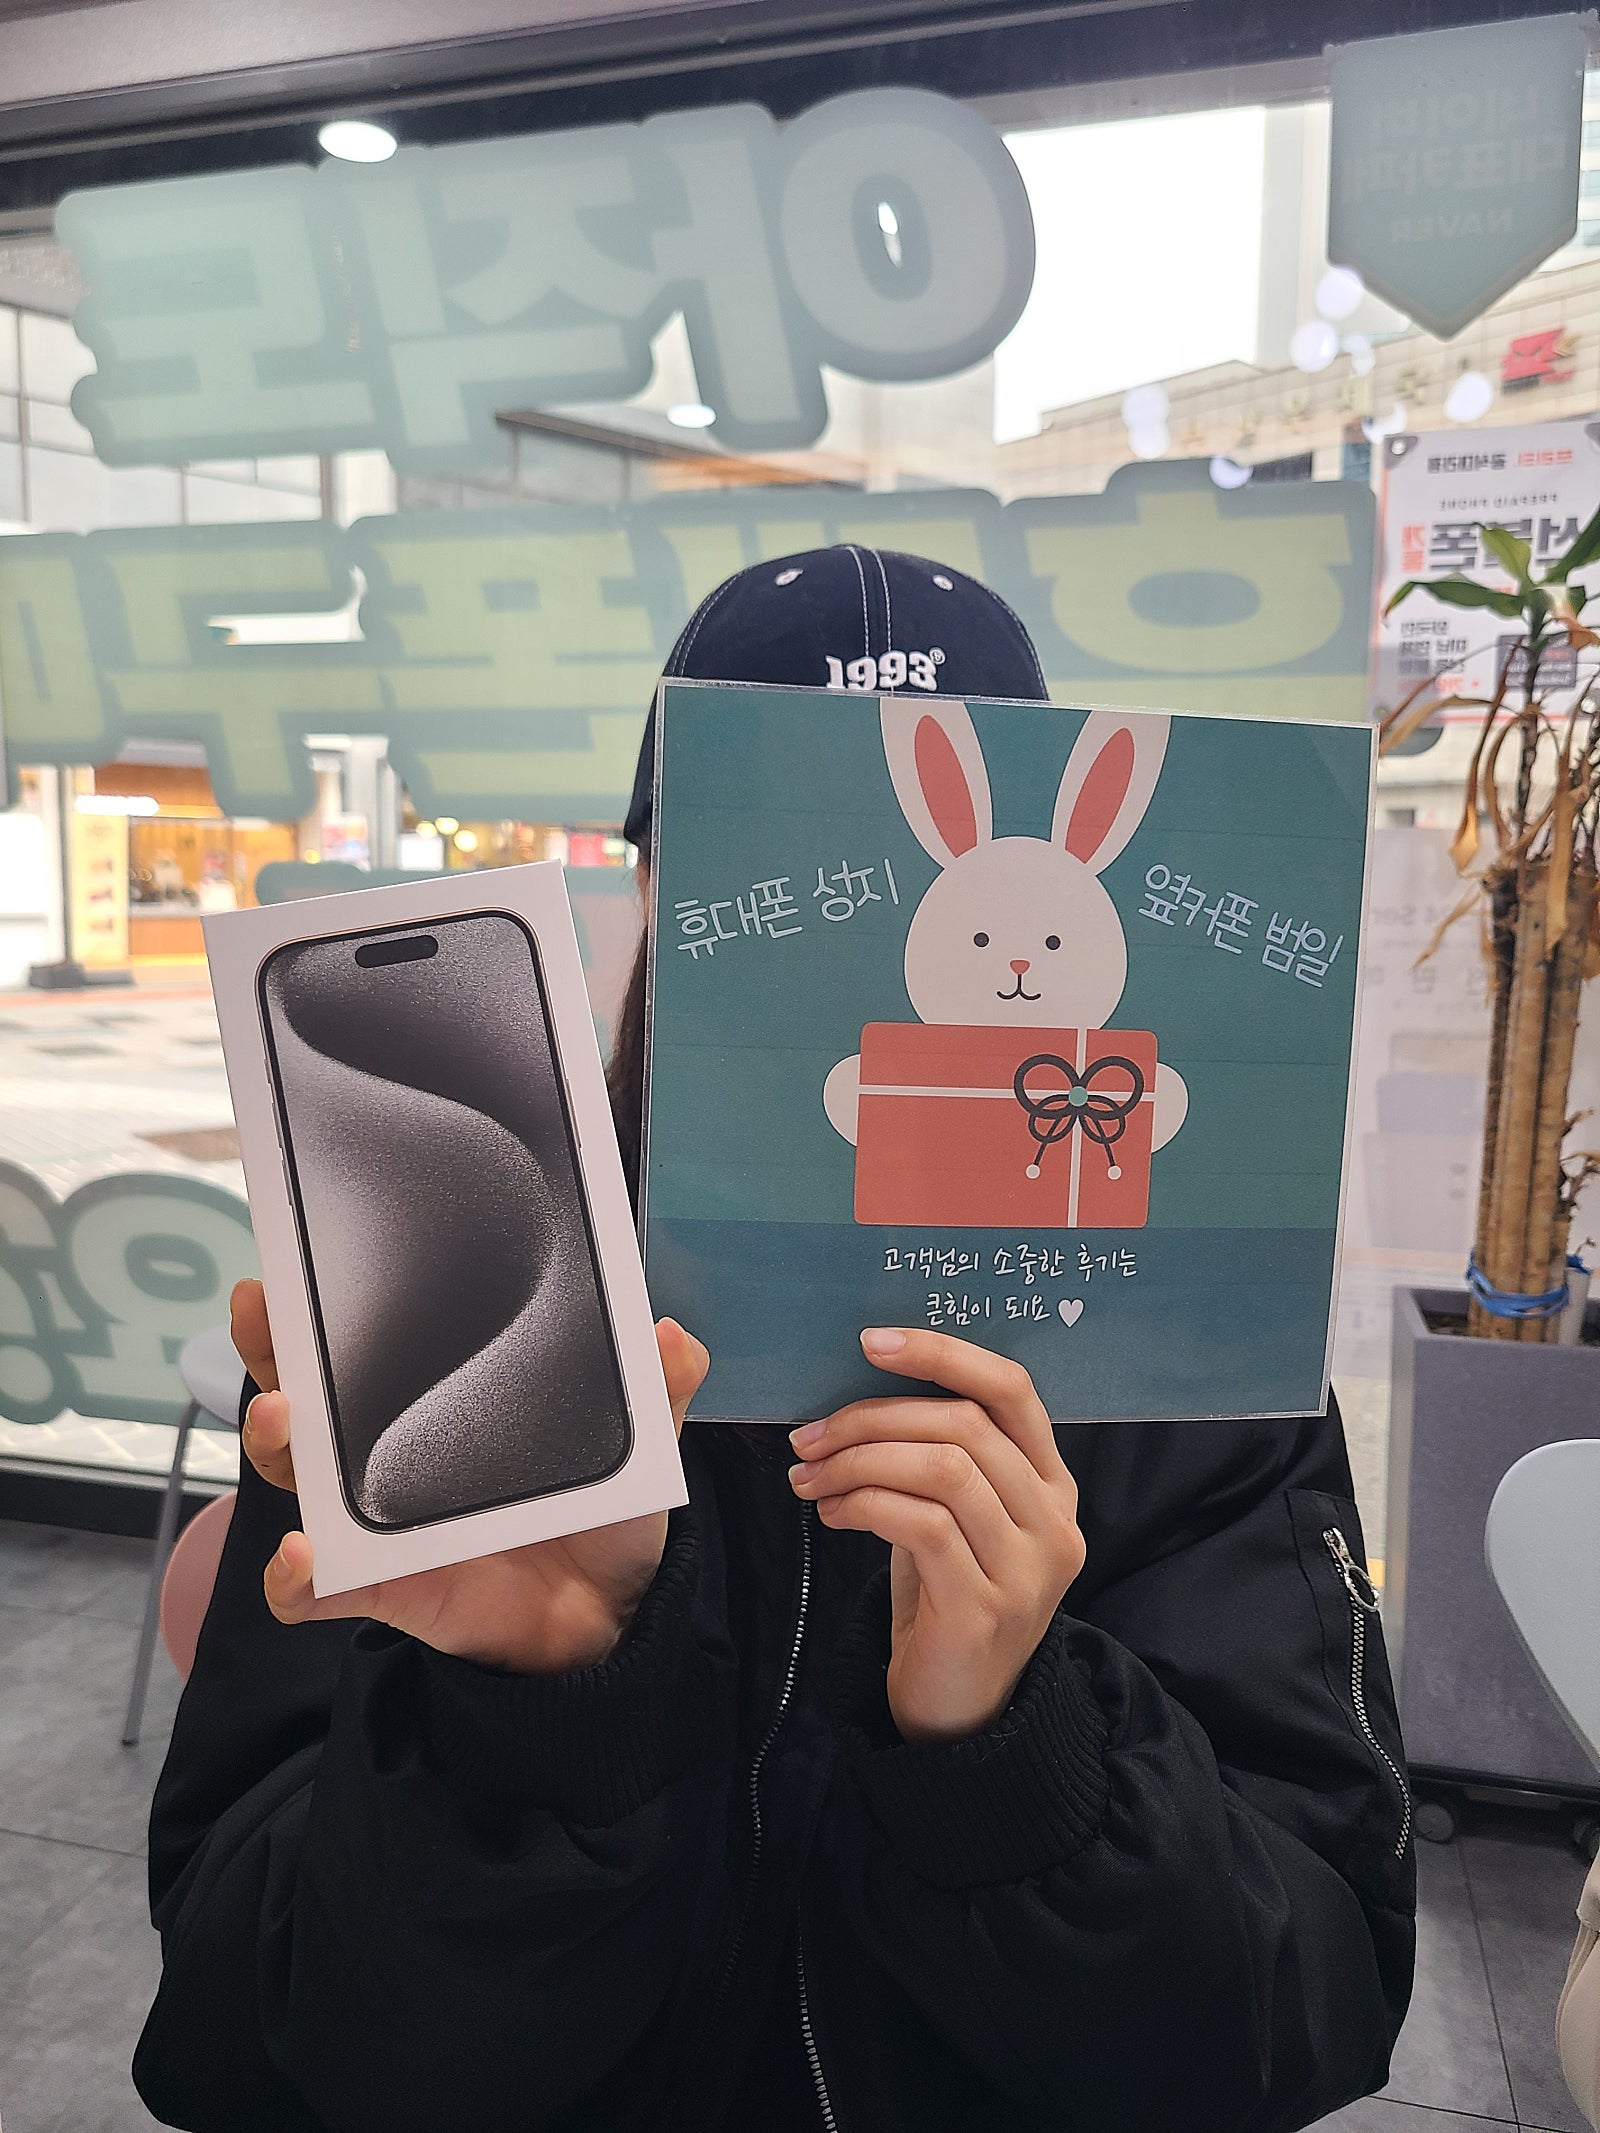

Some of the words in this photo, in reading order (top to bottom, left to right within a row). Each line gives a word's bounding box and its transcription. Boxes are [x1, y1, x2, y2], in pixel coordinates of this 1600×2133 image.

[674, 876, 803, 961] 휴대폰
[812, 858, 900, 923] 성지
[1138, 864, 1260, 955] 옆커폰
[1262, 911, 1345, 989] 범일
[883, 1247, 980, 1279] 고객님의
[994, 1243, 1066, 1285] 소중한
[1077, 1243, 1138, 1282] 후기는
[925, 1292, 991, 1326] 큰힘이
[1005, 1294, 1051, 1322] 되요
